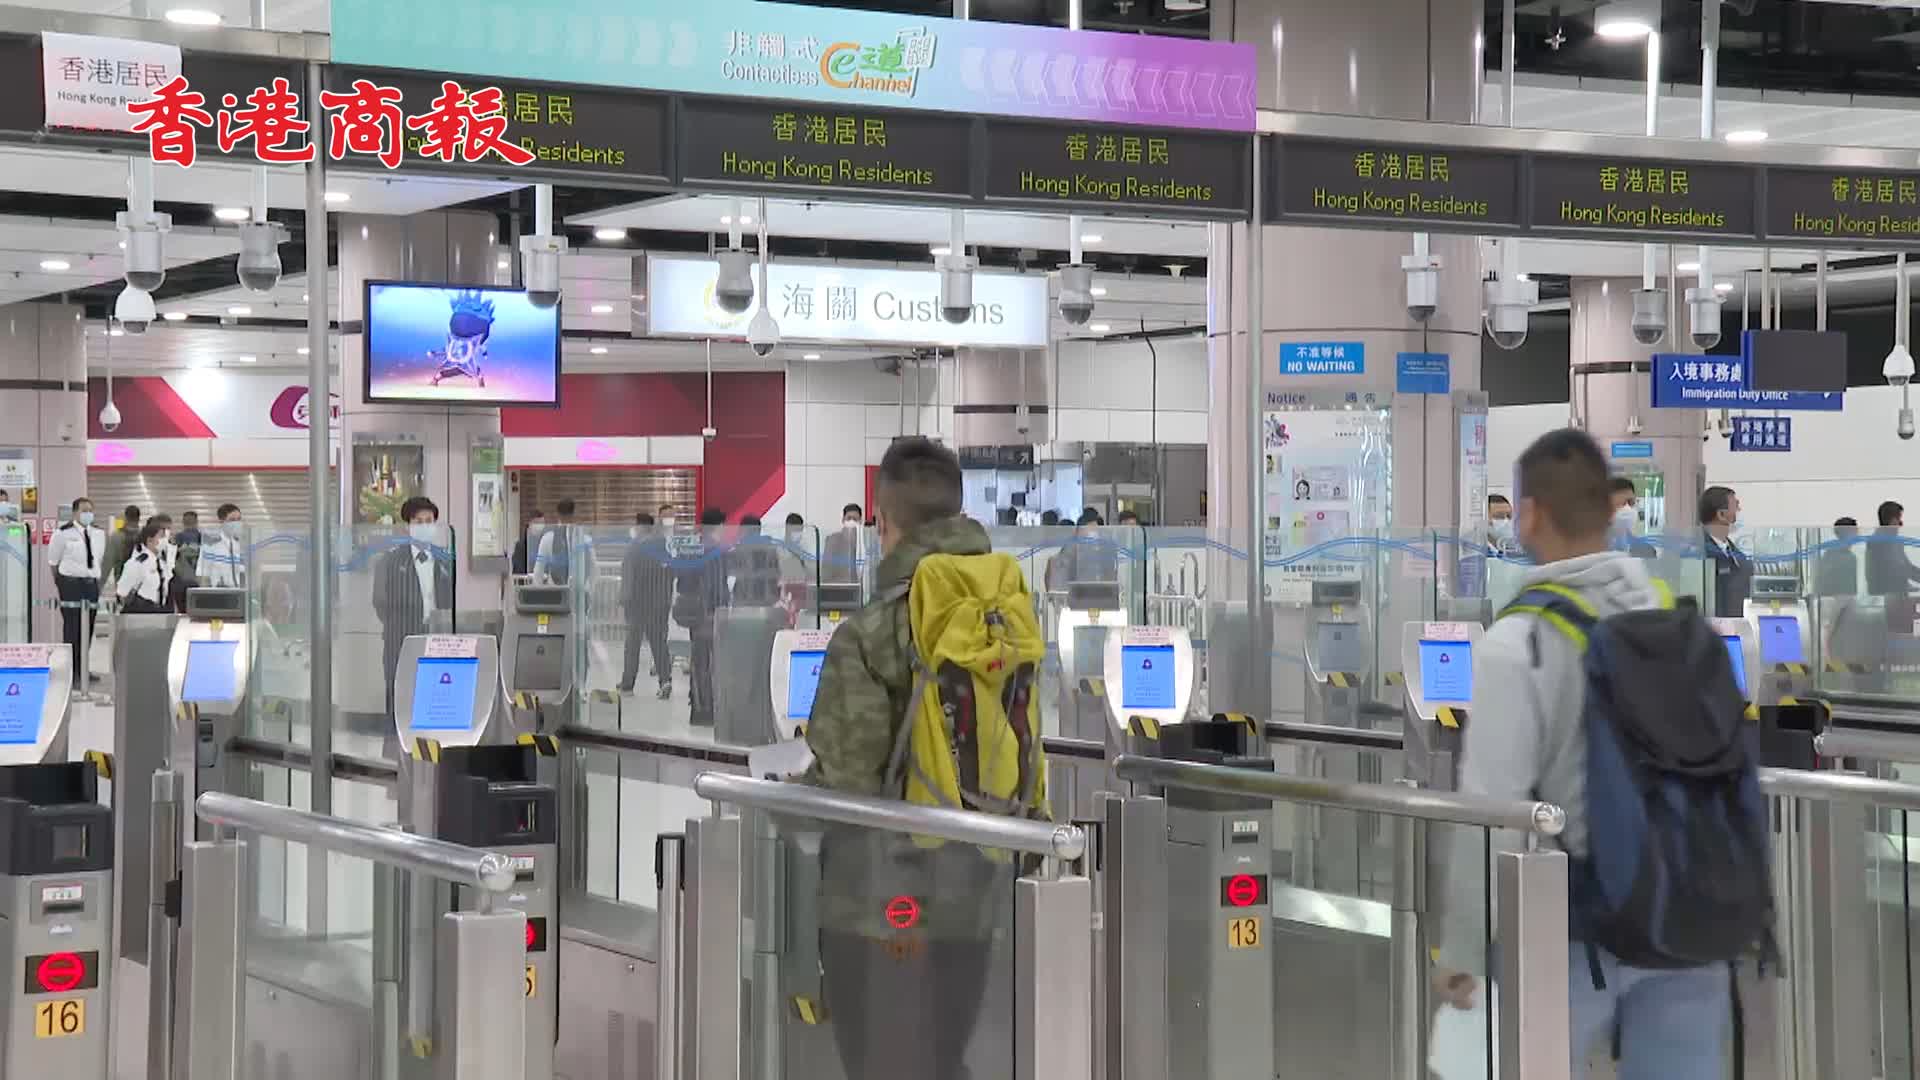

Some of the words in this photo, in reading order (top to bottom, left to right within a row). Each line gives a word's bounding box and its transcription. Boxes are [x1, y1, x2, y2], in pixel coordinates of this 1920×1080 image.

[59, 57, 167, 88] 香港居民
[722, 59, 819, 87] Contactless
[57, 91, 87, 104] Hong
[90, 94, 117, 106] Kong
[773, 113, 886, 147] 香港居民
[1065, 134, 1169, 164] 香港居民
[723, 152, 776, 179] Hong
[783, 155, 832, 183] Kong
[839, 159, 932, 184] Residents
[1355, 153, 1449, 182] 香港居民
[1600, 167, 1688, 194] 香港居民
[1020, 171, 1069, 197] Hong
[1075, 175, 1120, 199] Kong
[1127, 177, 1212, 200] Residents
[1832, 177, 1917, 204] 香港居民
[1313, 188, 1358, 213] Hong
[1363, 191, 1404, 215] Kong
[1410, 193, 1487, 216] Residents
[1561, 201, 1602, 225] Hong
[1607, 204, 1645, 227] Kong
[1650, 205, 1724, 227] Residents
[1794, 211, 1834, 235] Hong
[1838, 213, 1875, 236] Kong
[1880, 215, 1920, 233] Resid
[783, 283, 857, 321] 海關
[873, 290, 1004, 325] Custms
[1287, 361, 1302, 372] NO
[1307, 361, 1355, 372] WAITING
[1682, 387, 1737, 401] Immigration
[1232, 919, 1257, 946] 13
[42, 1000, 79, 1036] 16
